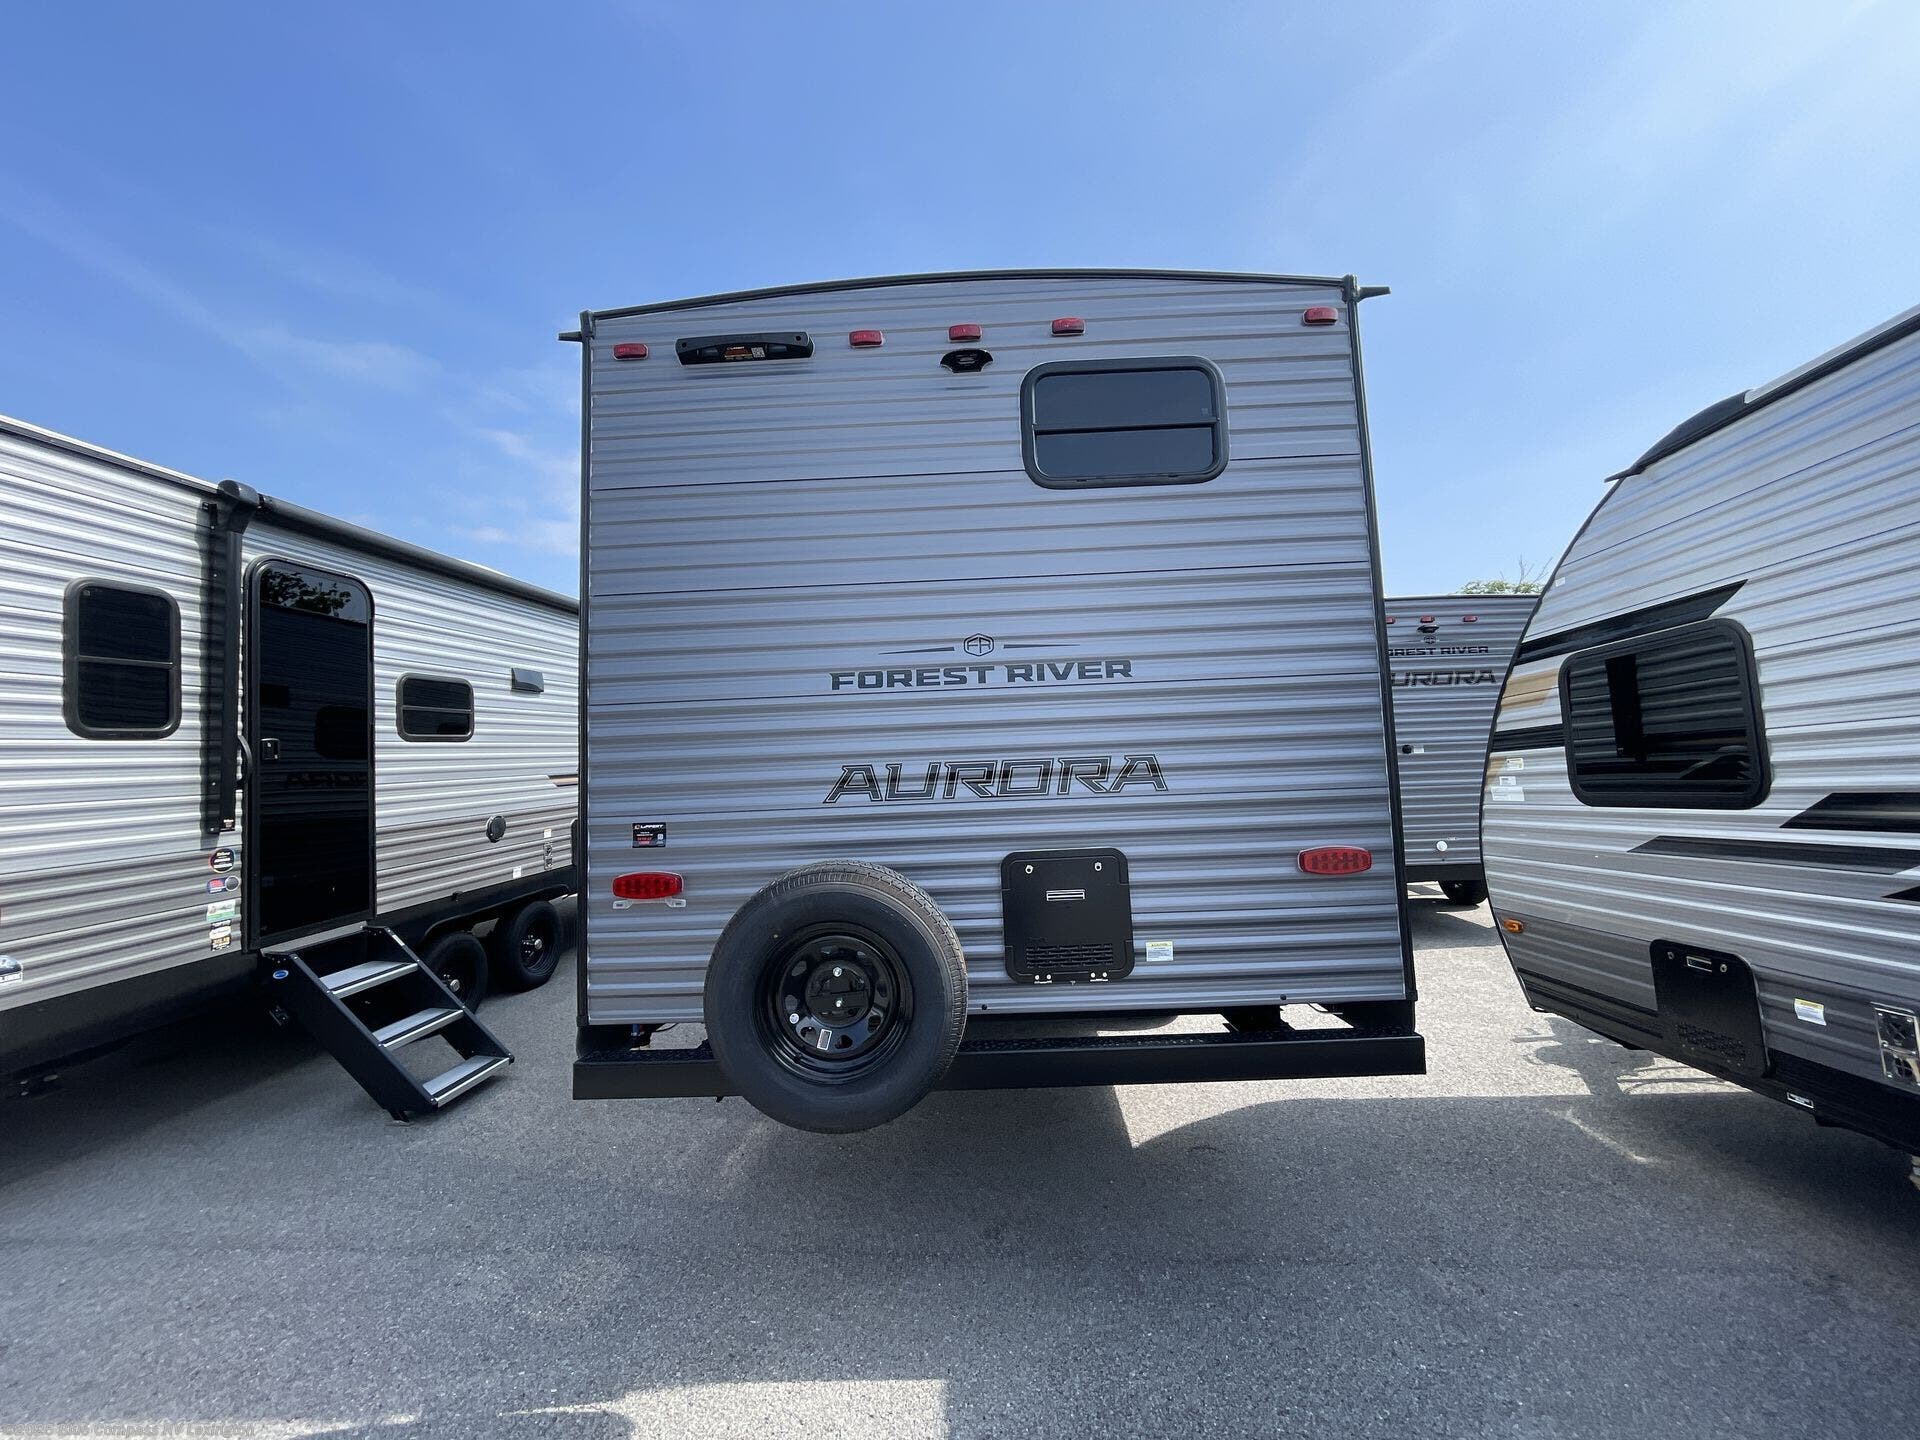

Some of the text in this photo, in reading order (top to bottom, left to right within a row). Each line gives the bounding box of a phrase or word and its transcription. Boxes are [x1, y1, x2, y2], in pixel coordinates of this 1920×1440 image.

[1388, 645, 1489, 656] OREST RIVER
[829, 659, 1133, 691] FOREST RIVER
[1391, 670, 1496, 687] URORA
[822, 753, 1170, 804] AURORA
